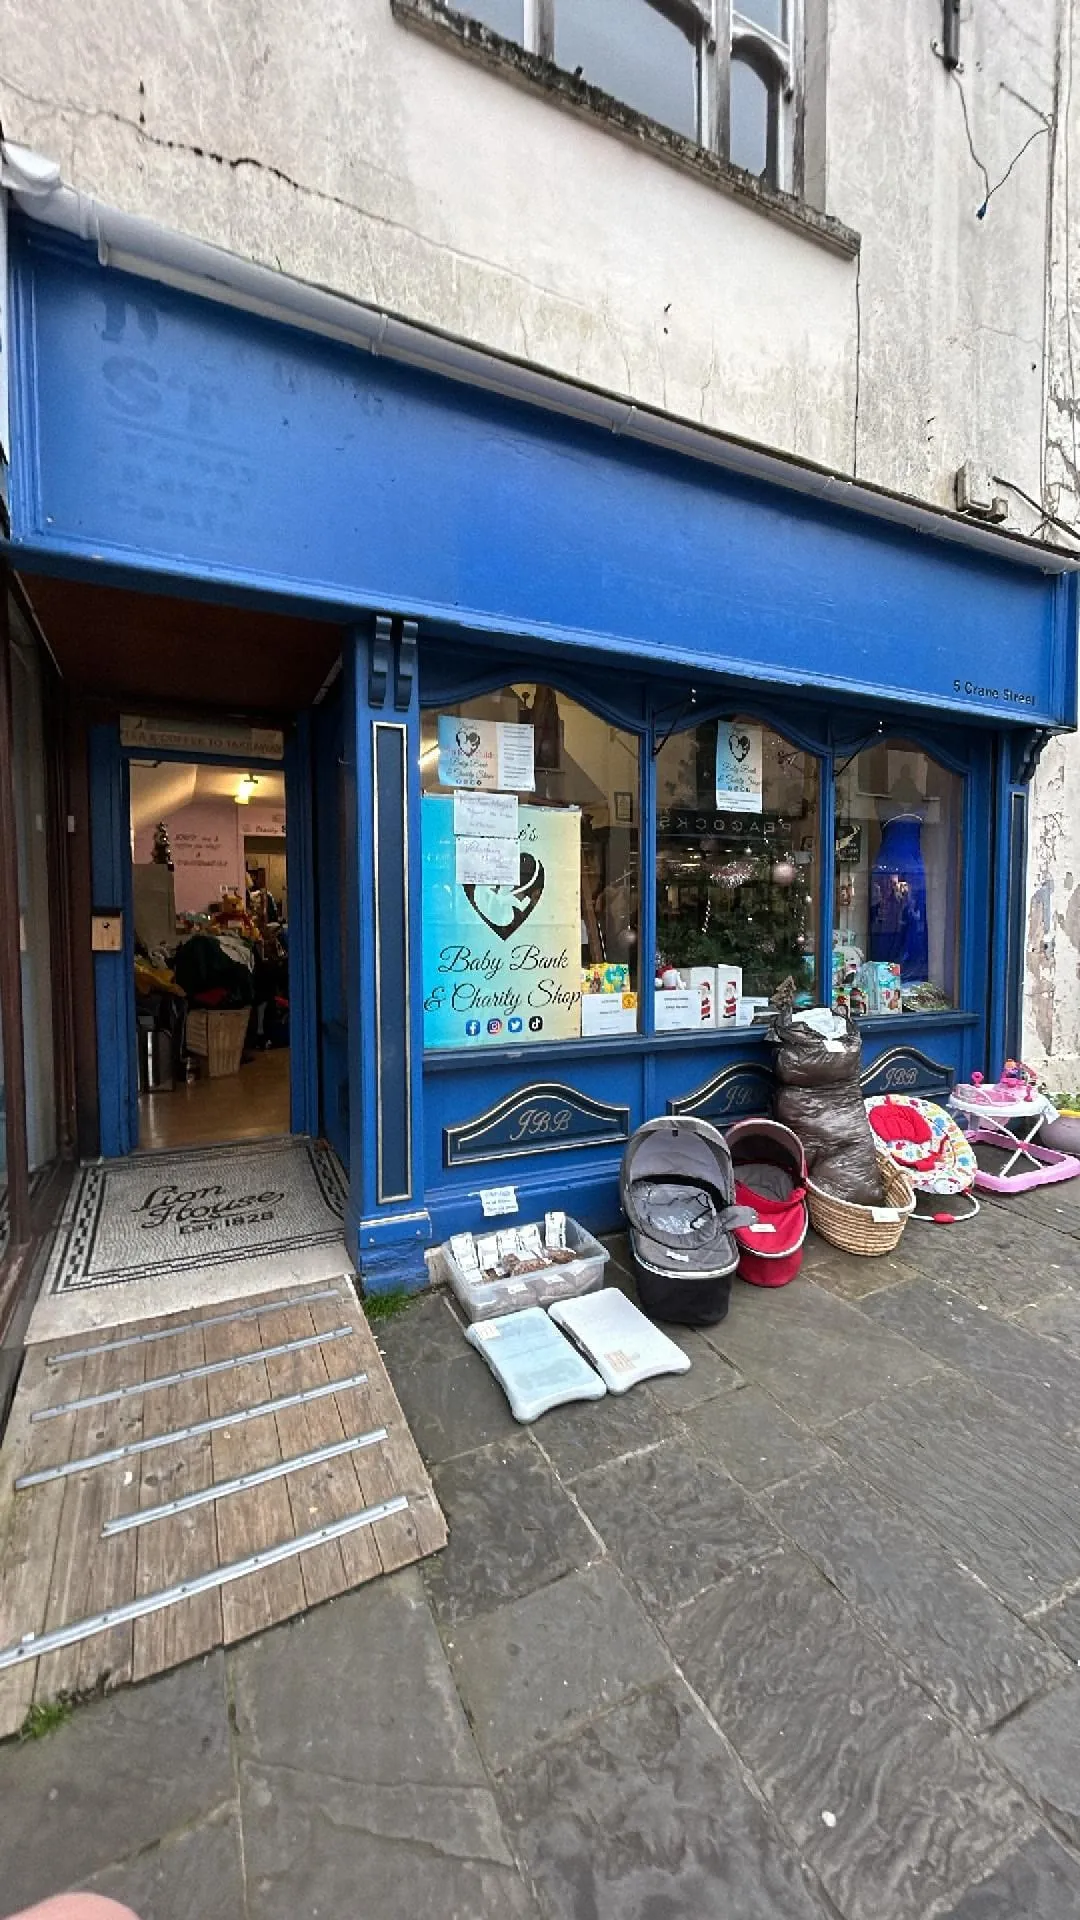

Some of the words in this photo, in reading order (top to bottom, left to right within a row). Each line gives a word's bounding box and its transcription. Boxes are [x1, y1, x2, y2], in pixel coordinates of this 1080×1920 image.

[953, 679, 961, 692] 5
[965, 681, 999, 699] Crane
[1003, 688, 1036, 706] Street
[438, 944, 504, 980] Baby
[509, 943, 569, 971] Bank
[423, 986, 446, 1012] &
[452, 981, 521, 1016] Charity
[528, 978, 581, 1011] Shop
[509, 1109, 573, 1141] JBB
[131, 1185, 226, 1213] Lion
[141, 1191, 285, 1229] House
